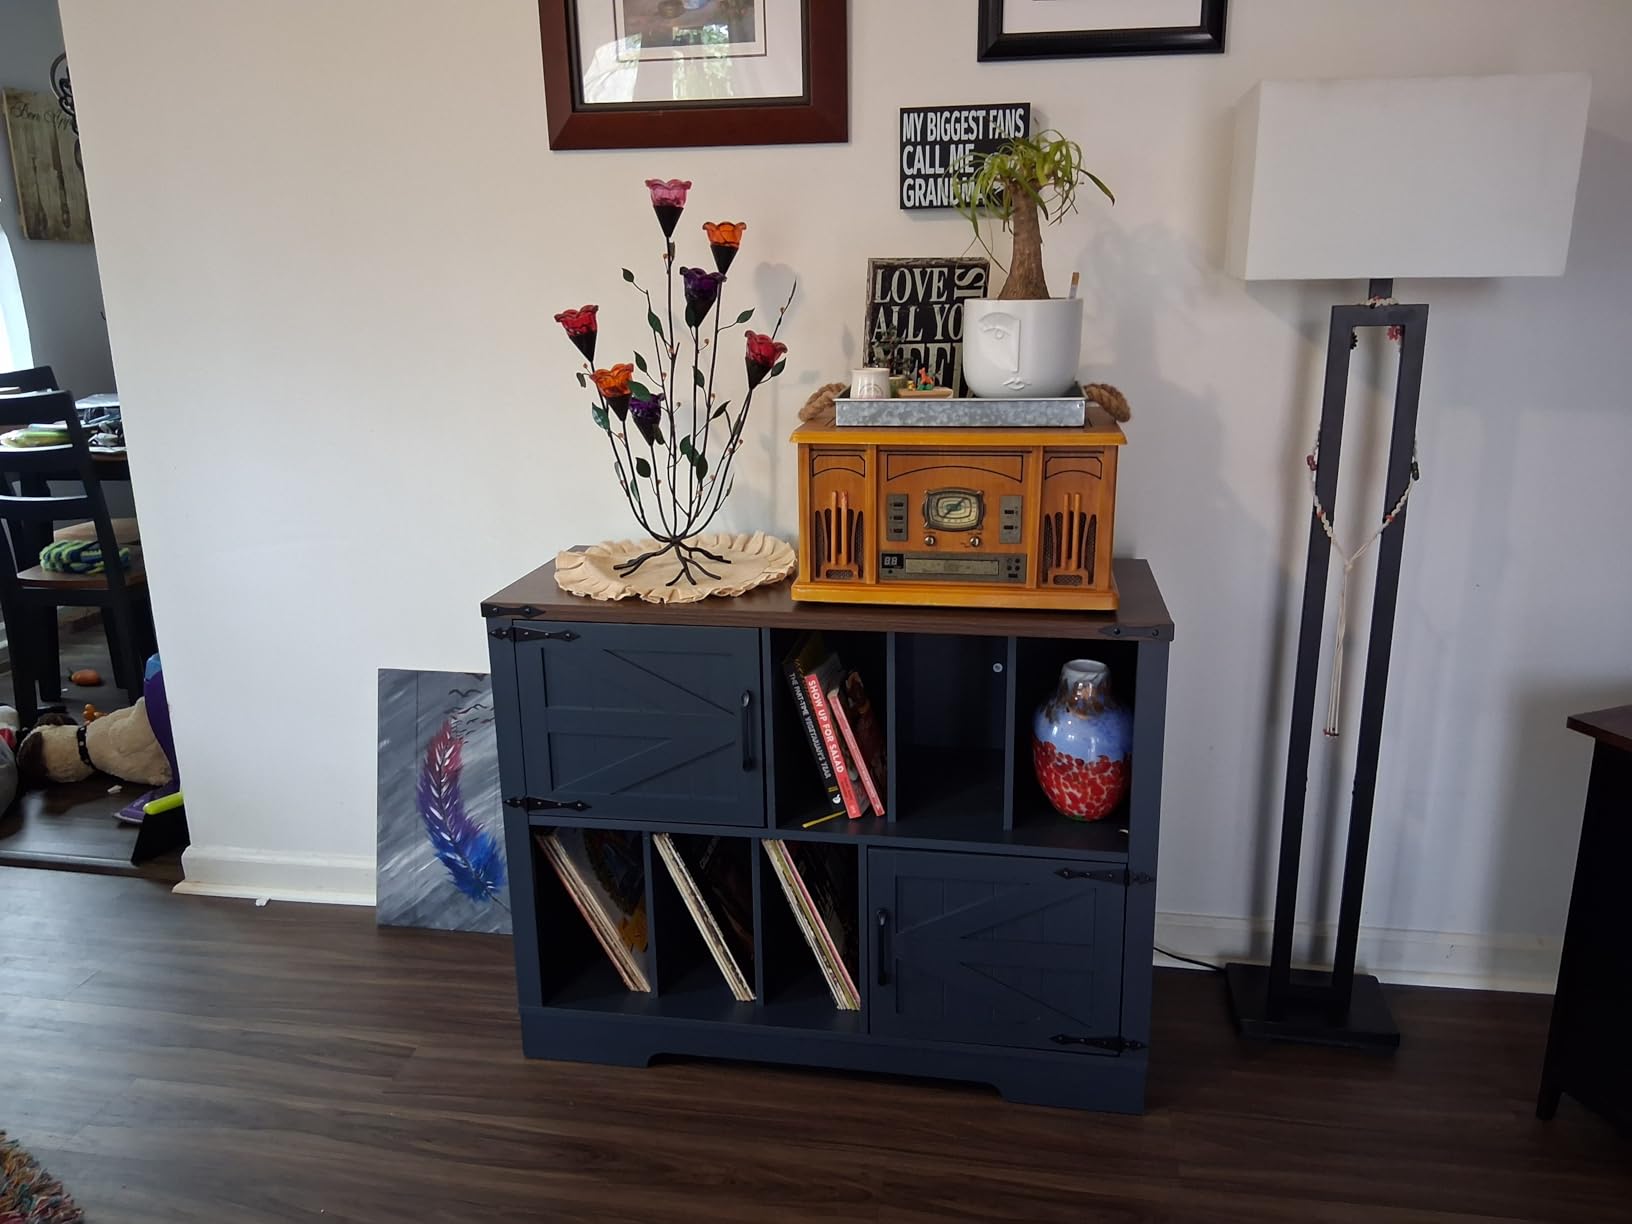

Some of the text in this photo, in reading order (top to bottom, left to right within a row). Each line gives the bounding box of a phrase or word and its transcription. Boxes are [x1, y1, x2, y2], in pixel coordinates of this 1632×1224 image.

[903, 108, 1024, 142] MY BIGGEST FANS
[903, 143, 974, 175] CALL ME
[874, 267, 986, 303] LOVE IS
[871, 303, 964, 342] ALL YO
[808, 679, 823, 707] SHOW
[818, 709, 827, 721] UP
[822, 723, 834, 742] FOR
[829, 743, 844, 773] SALAD
